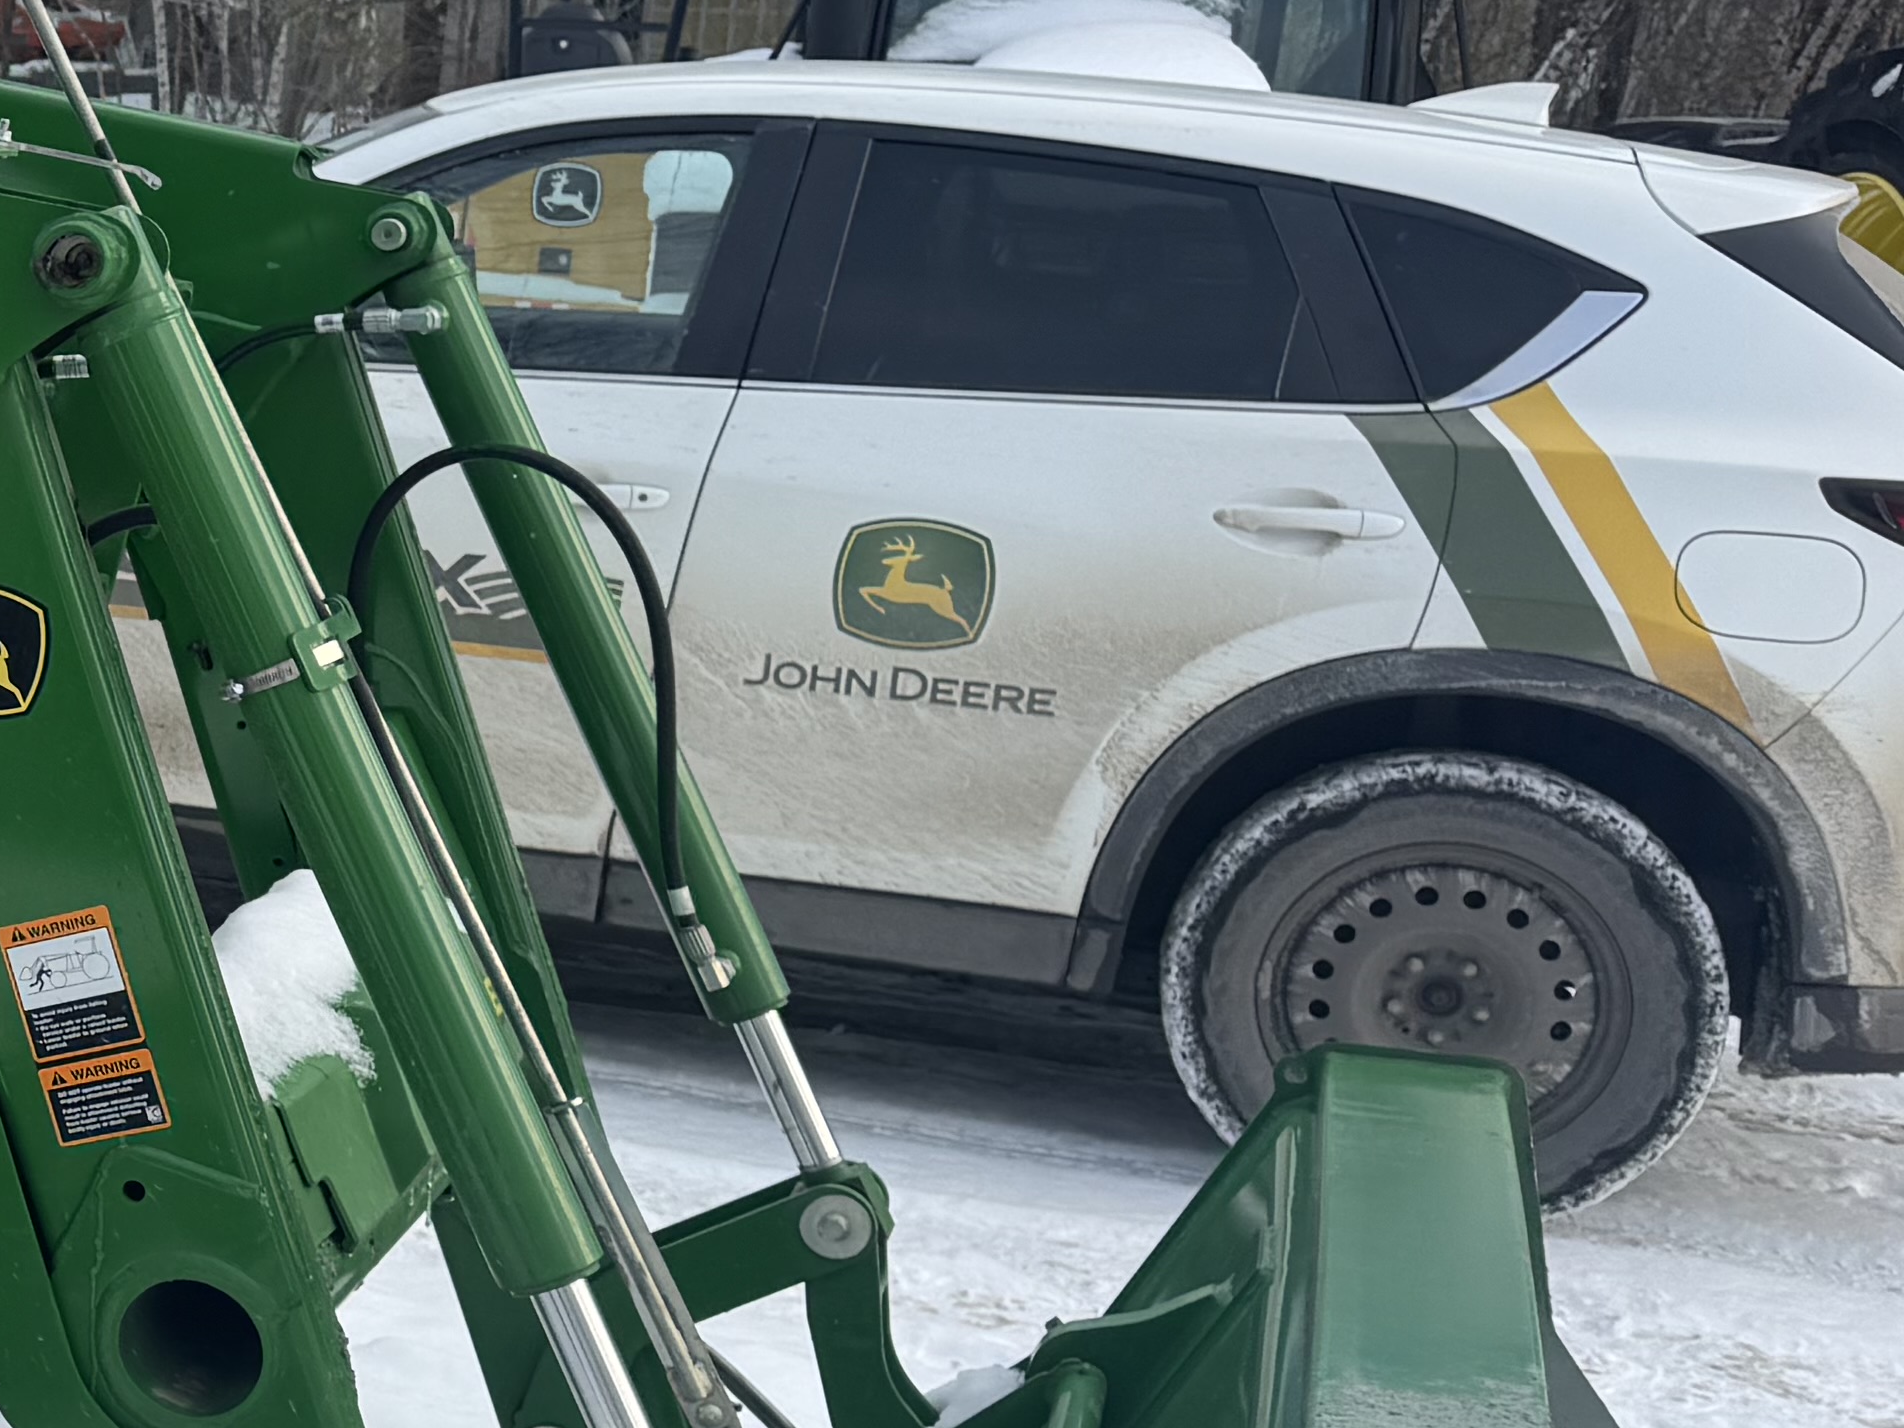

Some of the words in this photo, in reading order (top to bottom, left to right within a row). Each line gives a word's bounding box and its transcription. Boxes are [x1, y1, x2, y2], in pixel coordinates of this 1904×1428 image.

[743, 653, 878, 699] JOHN
[891, 666, 1059, 717] DEERE
[26, 913, 96, 939] WARNING
[70, 1057, 141, 1081] WARNING
